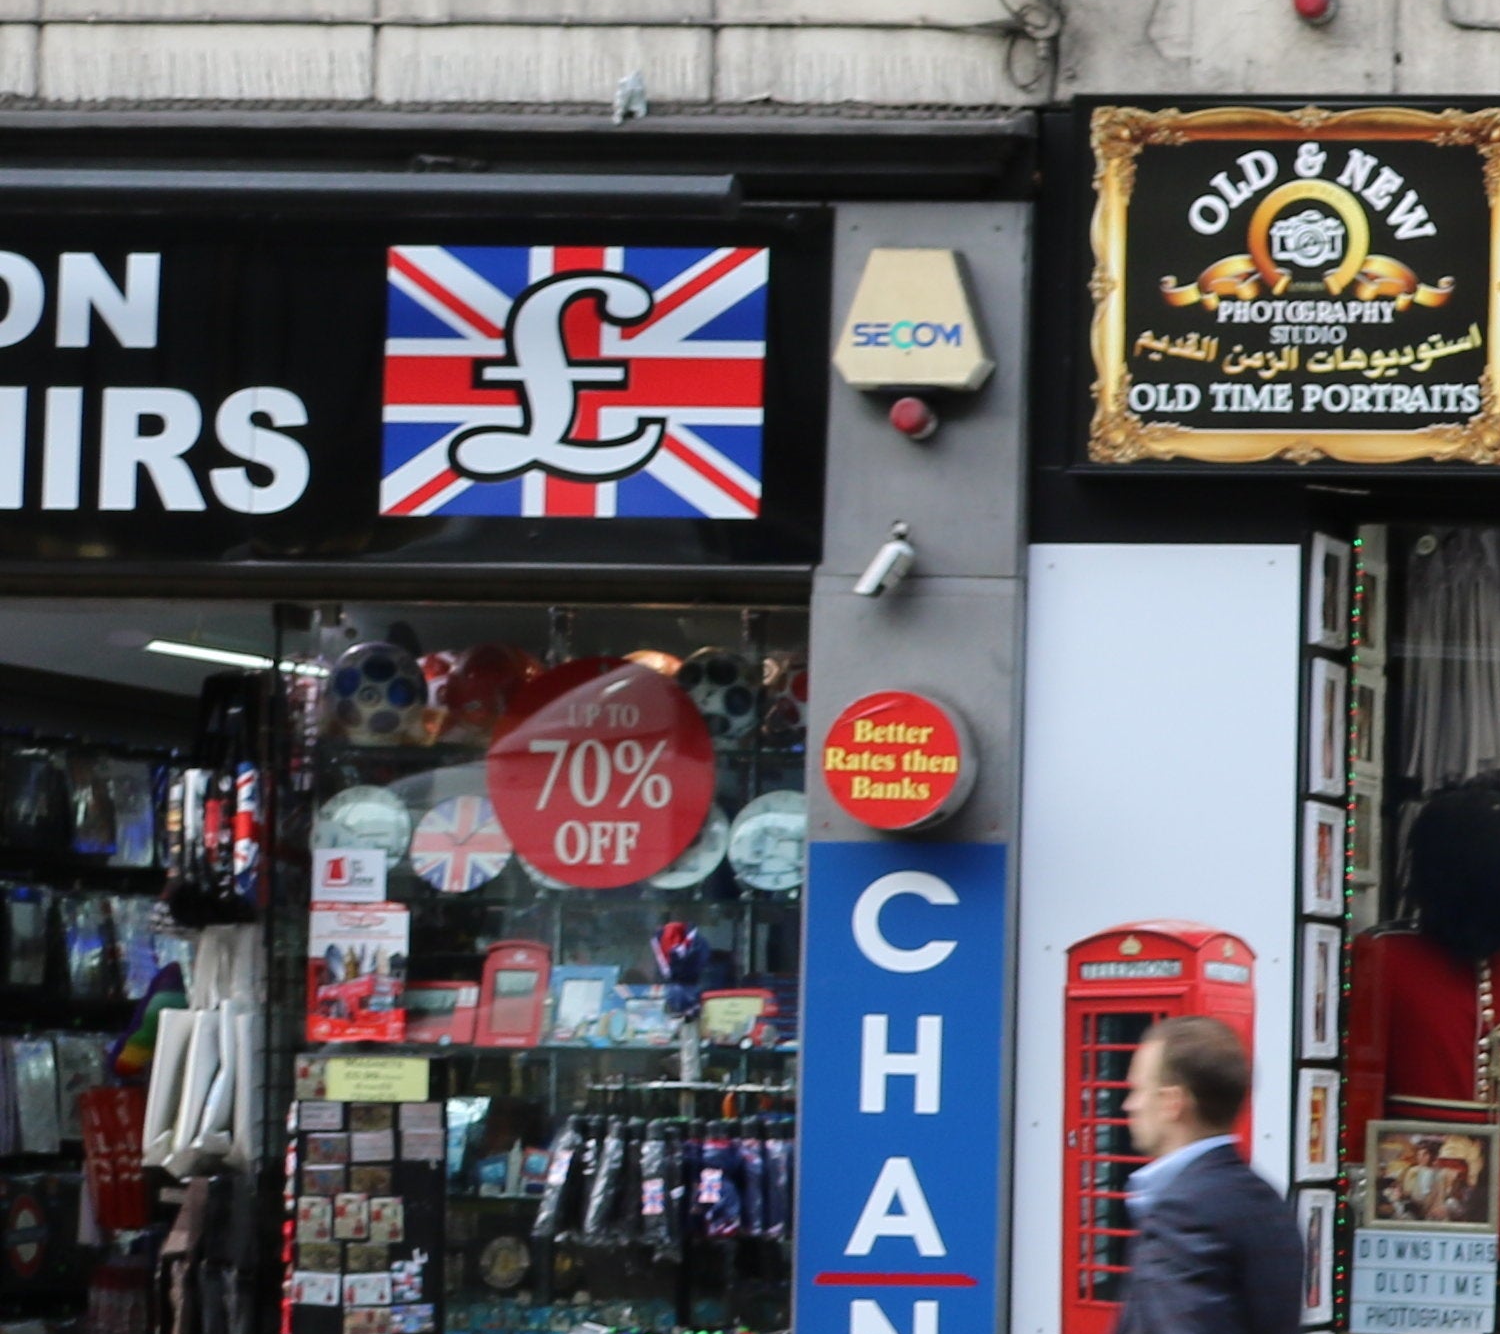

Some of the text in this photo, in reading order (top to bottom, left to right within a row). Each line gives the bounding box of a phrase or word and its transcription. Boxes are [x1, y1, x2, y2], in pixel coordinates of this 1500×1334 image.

[1189, 141, 1438, 244] OLD & NEW
[1216, 300, 1396, 323] PHOTOGRAPHY
[852, 321, 962, 348] SECOM
[1269, 325, 1348, 345] STUDIO
[1128, 383, 1482, 414] OLD TIME PORTRAITS
[607, 702, 641, 729] TO
[853, 718, 934, 745] Better
[825, 747, 959, 773] Rates then
[528, 738, 672, 810] 70%
[851, 776, 931, 801] Banks
[554, 819, 641, 866] OFF
[1365, 1305, 1485, 1330] PHOTOGRAPHY
